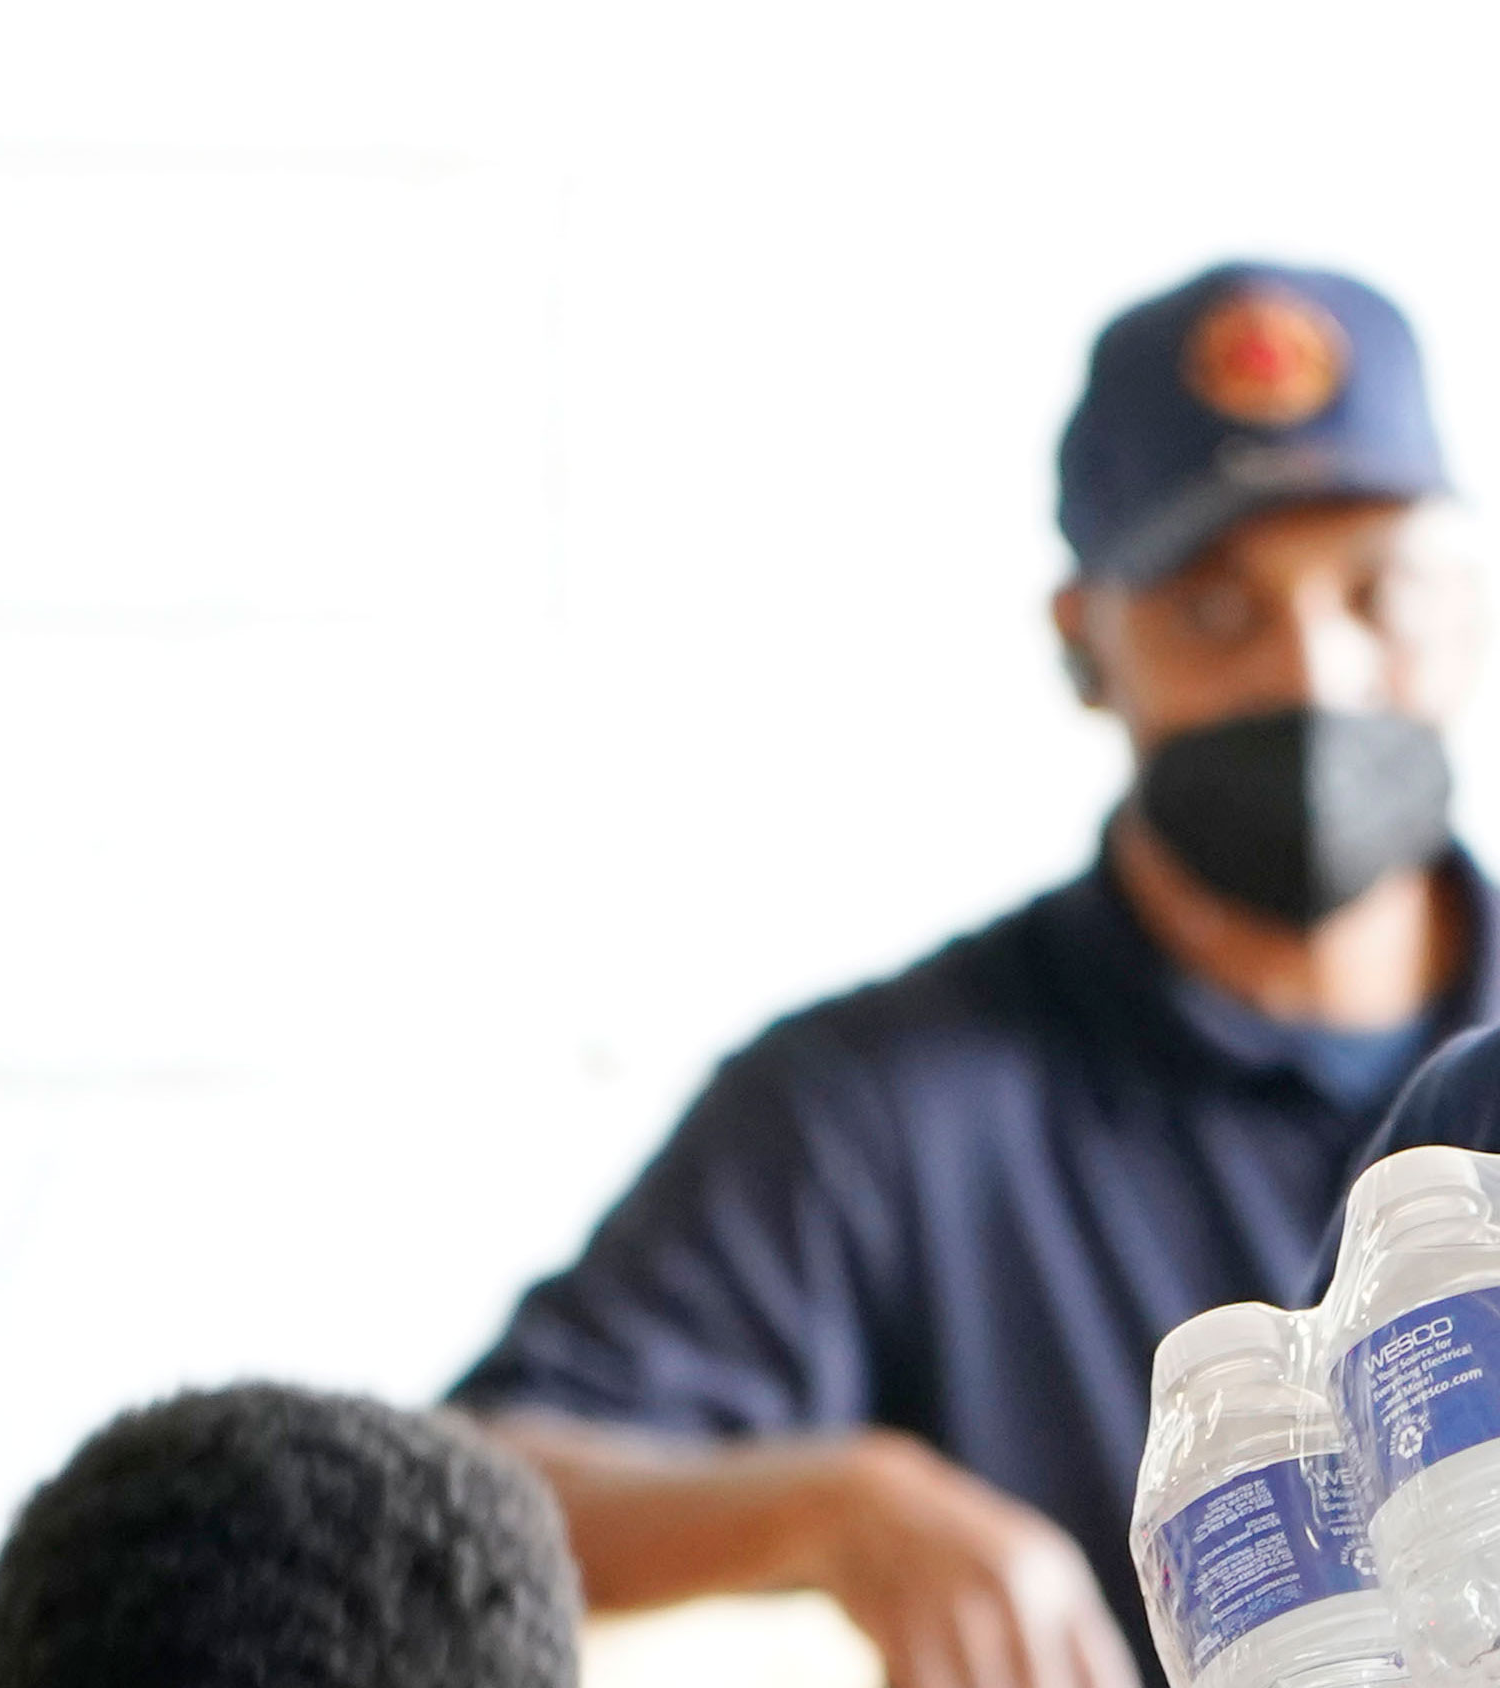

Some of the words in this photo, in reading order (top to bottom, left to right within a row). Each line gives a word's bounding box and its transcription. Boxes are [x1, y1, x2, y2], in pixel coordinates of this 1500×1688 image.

[1363, 1316, 1453, 1375] WESCO
[1422, 1343, 1473, 1372] Electrical
[1435, 1338, 1452, 1352] for
